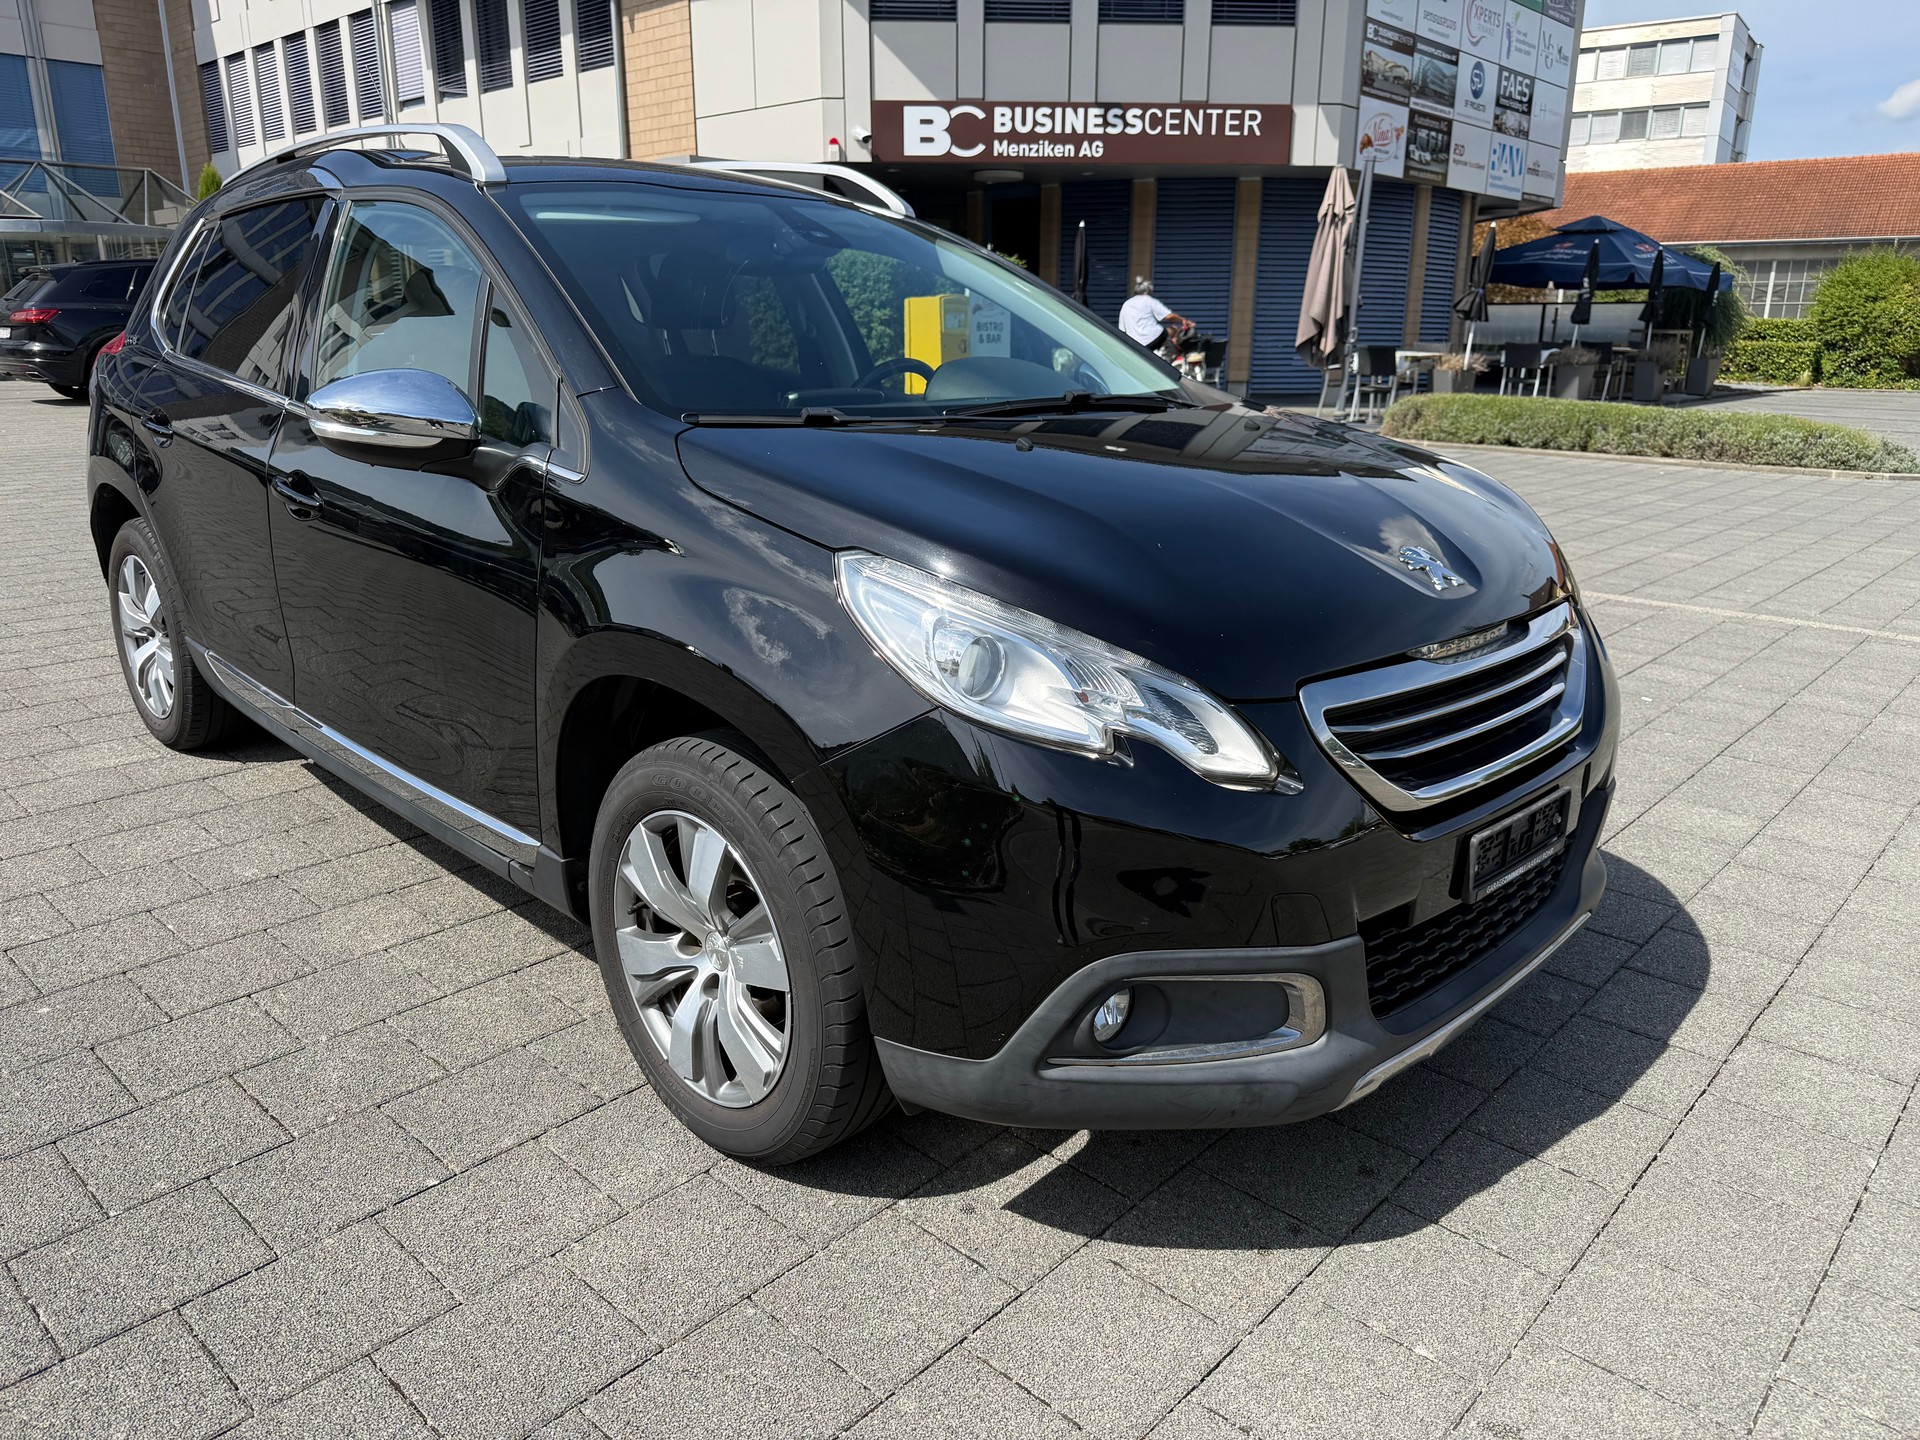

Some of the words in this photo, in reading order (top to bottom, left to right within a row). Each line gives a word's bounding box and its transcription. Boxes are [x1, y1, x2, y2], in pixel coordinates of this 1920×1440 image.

[1474, 3, 1501, 28] XPERTS
[1501, 71, 1530, 102] FAES
[903, 105, 986, 158] BC
[993, 106, 1262, 137] BUSINESSCENTER
[992, 139, 1075, 158] Menziken
[1079, 140, 1105, 158] AG
[976, 321, 1004, 332] BISTRO
[985, 333, 1002, 344] BAR
